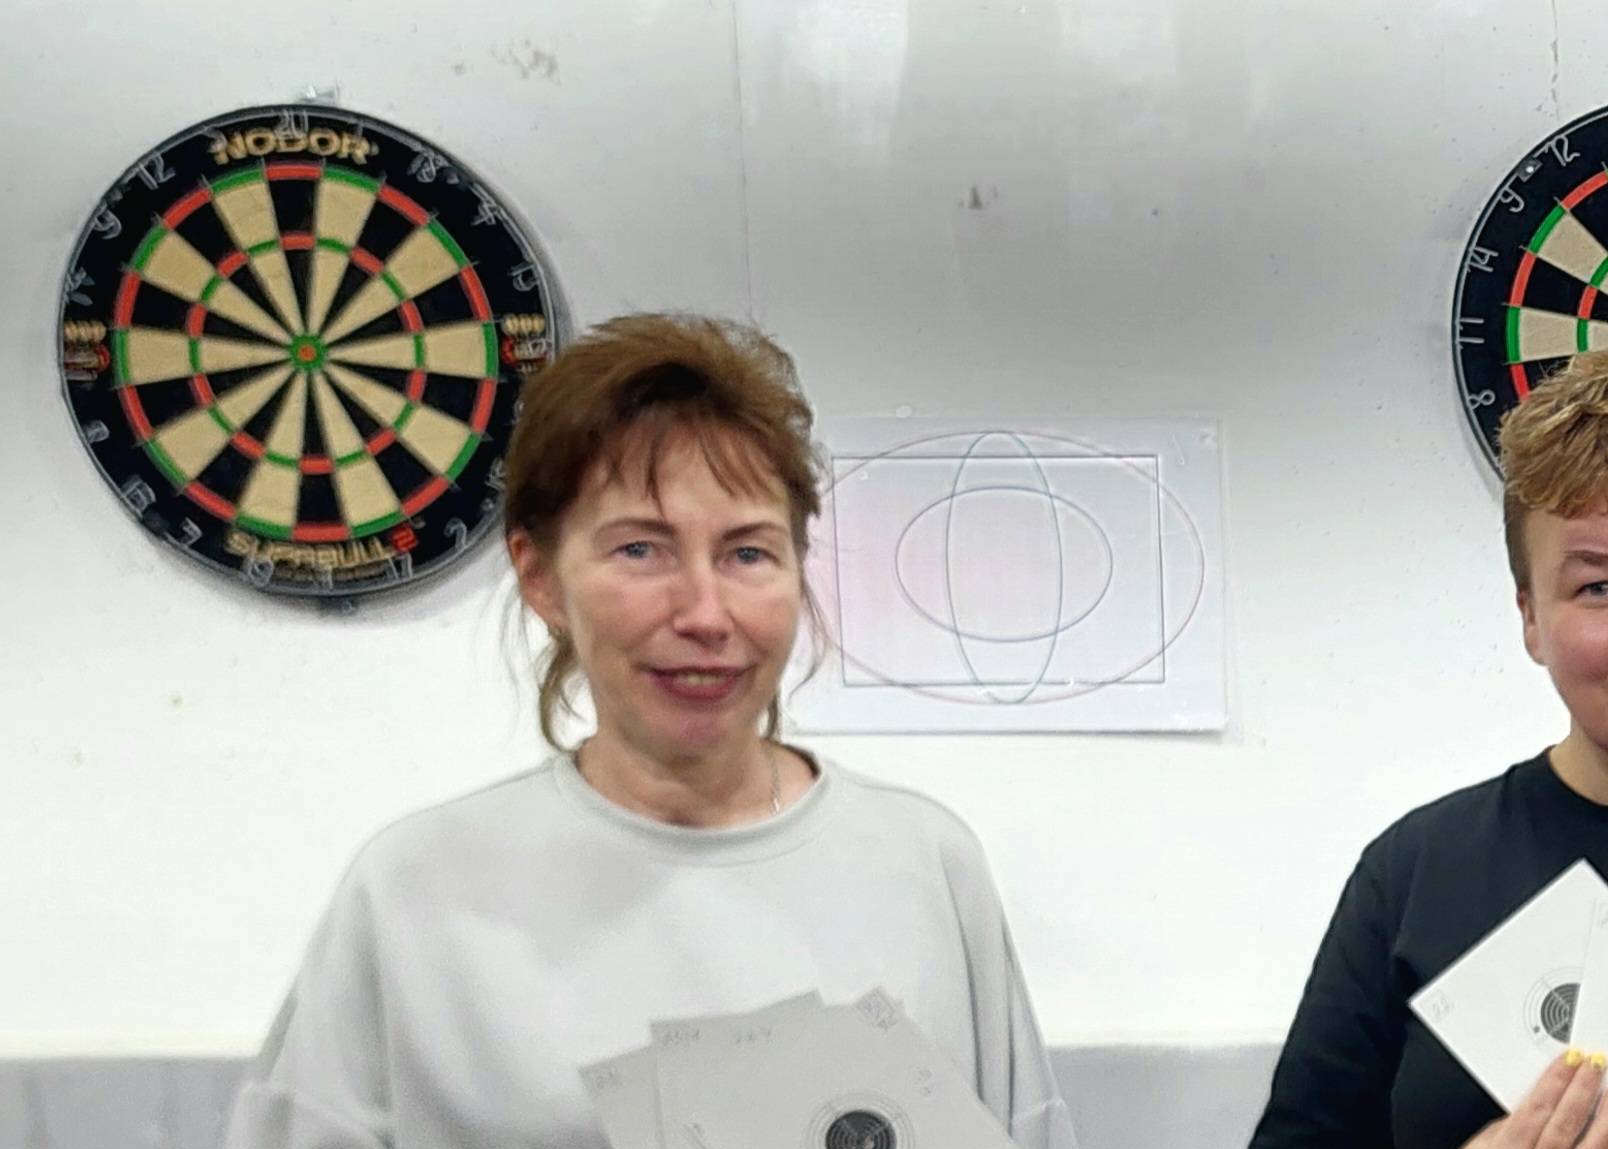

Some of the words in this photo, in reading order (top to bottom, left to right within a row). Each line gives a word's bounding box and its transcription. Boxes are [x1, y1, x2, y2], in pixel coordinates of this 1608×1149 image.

[1543, 135, 1581, 167] 12
[1499, 185, 1525, 213] 9
[1466, 244, 1500, 274] 14
[1457, 316, 1486, 350] 11
[1468, 388, 1496, 411] 8
